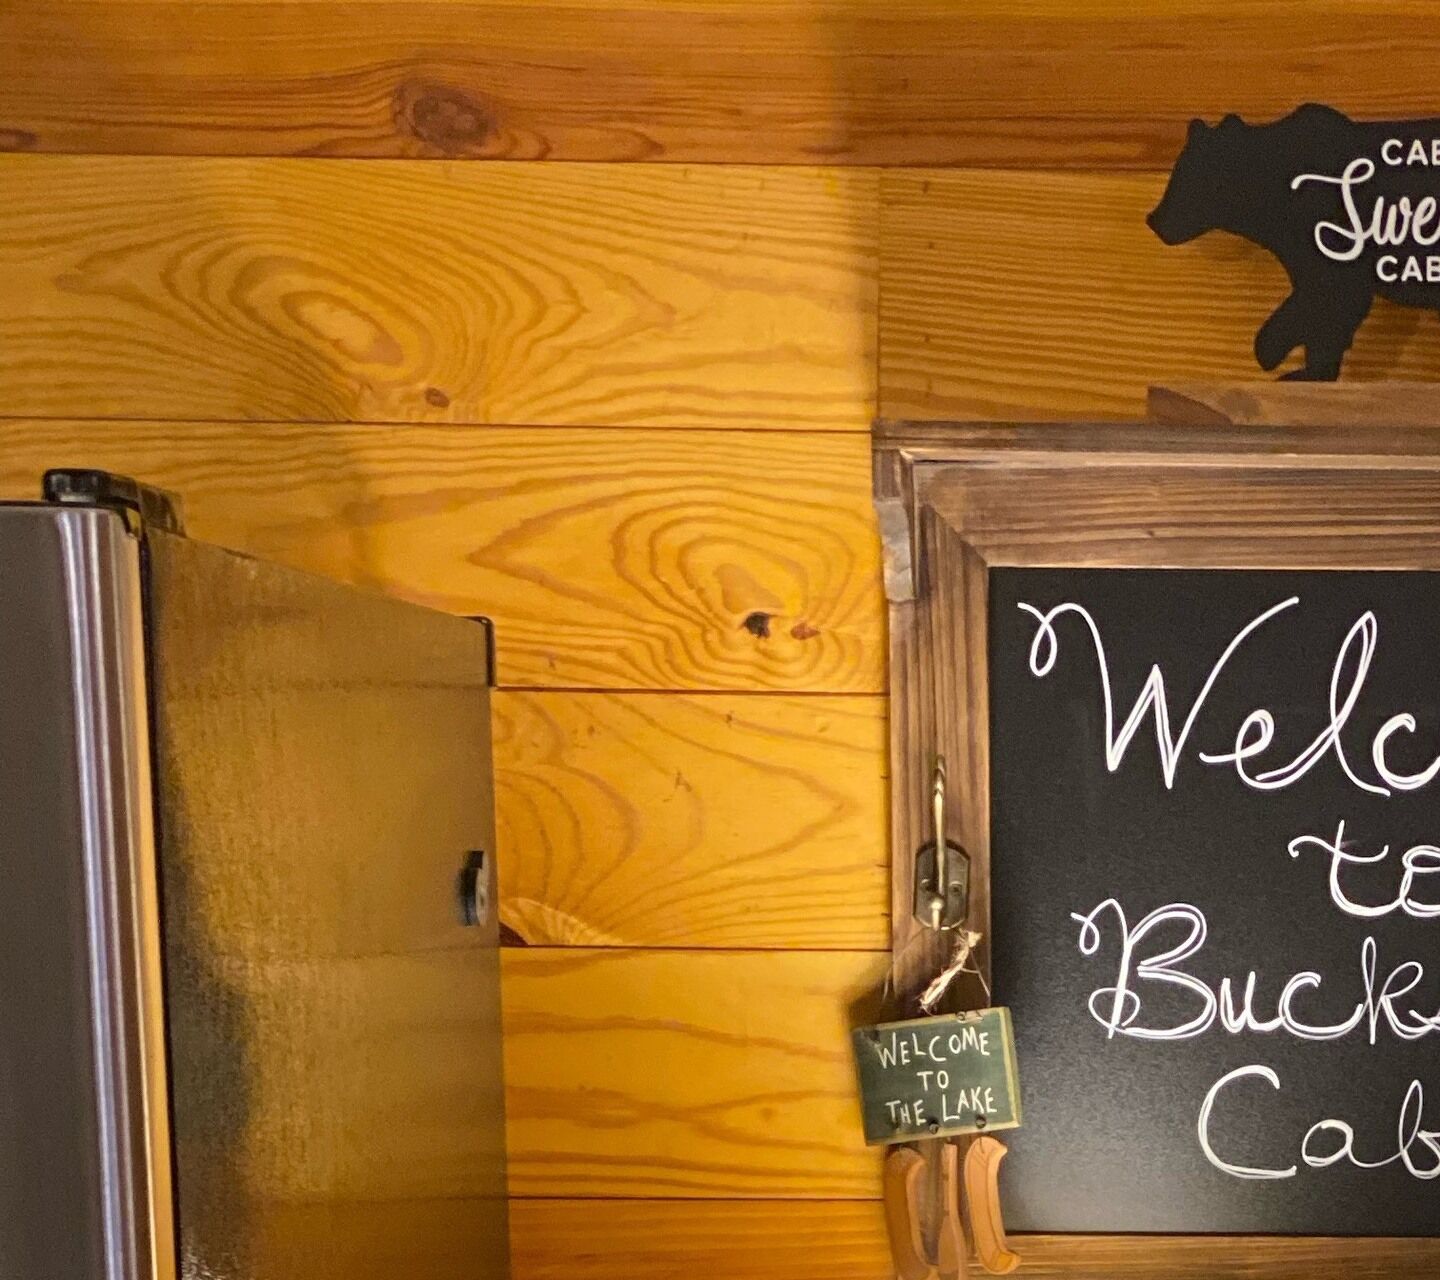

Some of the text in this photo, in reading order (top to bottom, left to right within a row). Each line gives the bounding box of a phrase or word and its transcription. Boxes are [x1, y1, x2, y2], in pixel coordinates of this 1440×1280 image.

[878, 1026, 991, 1069] WELCOME
[916, 1070, 950, 1091] TO
[884, 1086, 998, 1126] THE LAKE
